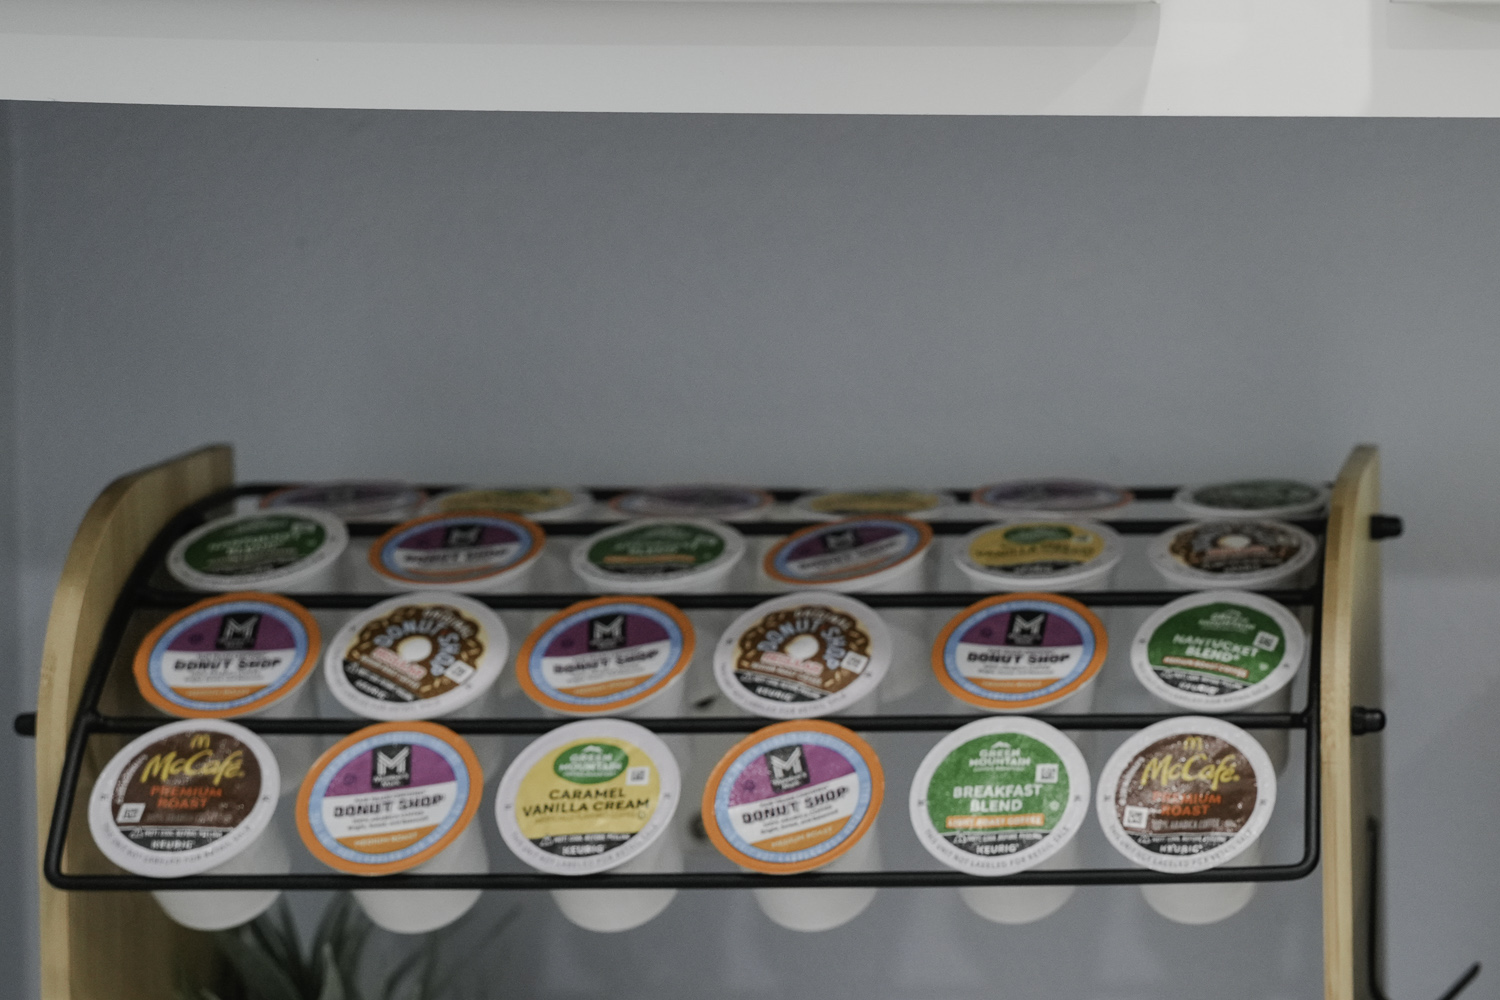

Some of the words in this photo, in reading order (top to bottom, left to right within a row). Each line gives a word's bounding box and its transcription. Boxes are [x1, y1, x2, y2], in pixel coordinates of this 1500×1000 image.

[150, 785, 223, 798] PREMIUM
[549, 787, 627, 801] CARAMEL
[953, 784, 1043, 799] BREAKFAST
[1152, 790, 1222, 804] PREMIUM
[157, 797, 208, 810] ROAST
[334, 801, 393, 818] DONUT
[397, 794, 444, 811] SHOP
[522, 801, 588, 818] VANILLA
[593, 798, 651, 811] CREAM
[741, 802, 800, 824] DONUT
[804, 786, 849, 809] SHOP
[970, 799, 1023, 813] BLEND
[1161, 804, 1211, 816] ROAST
